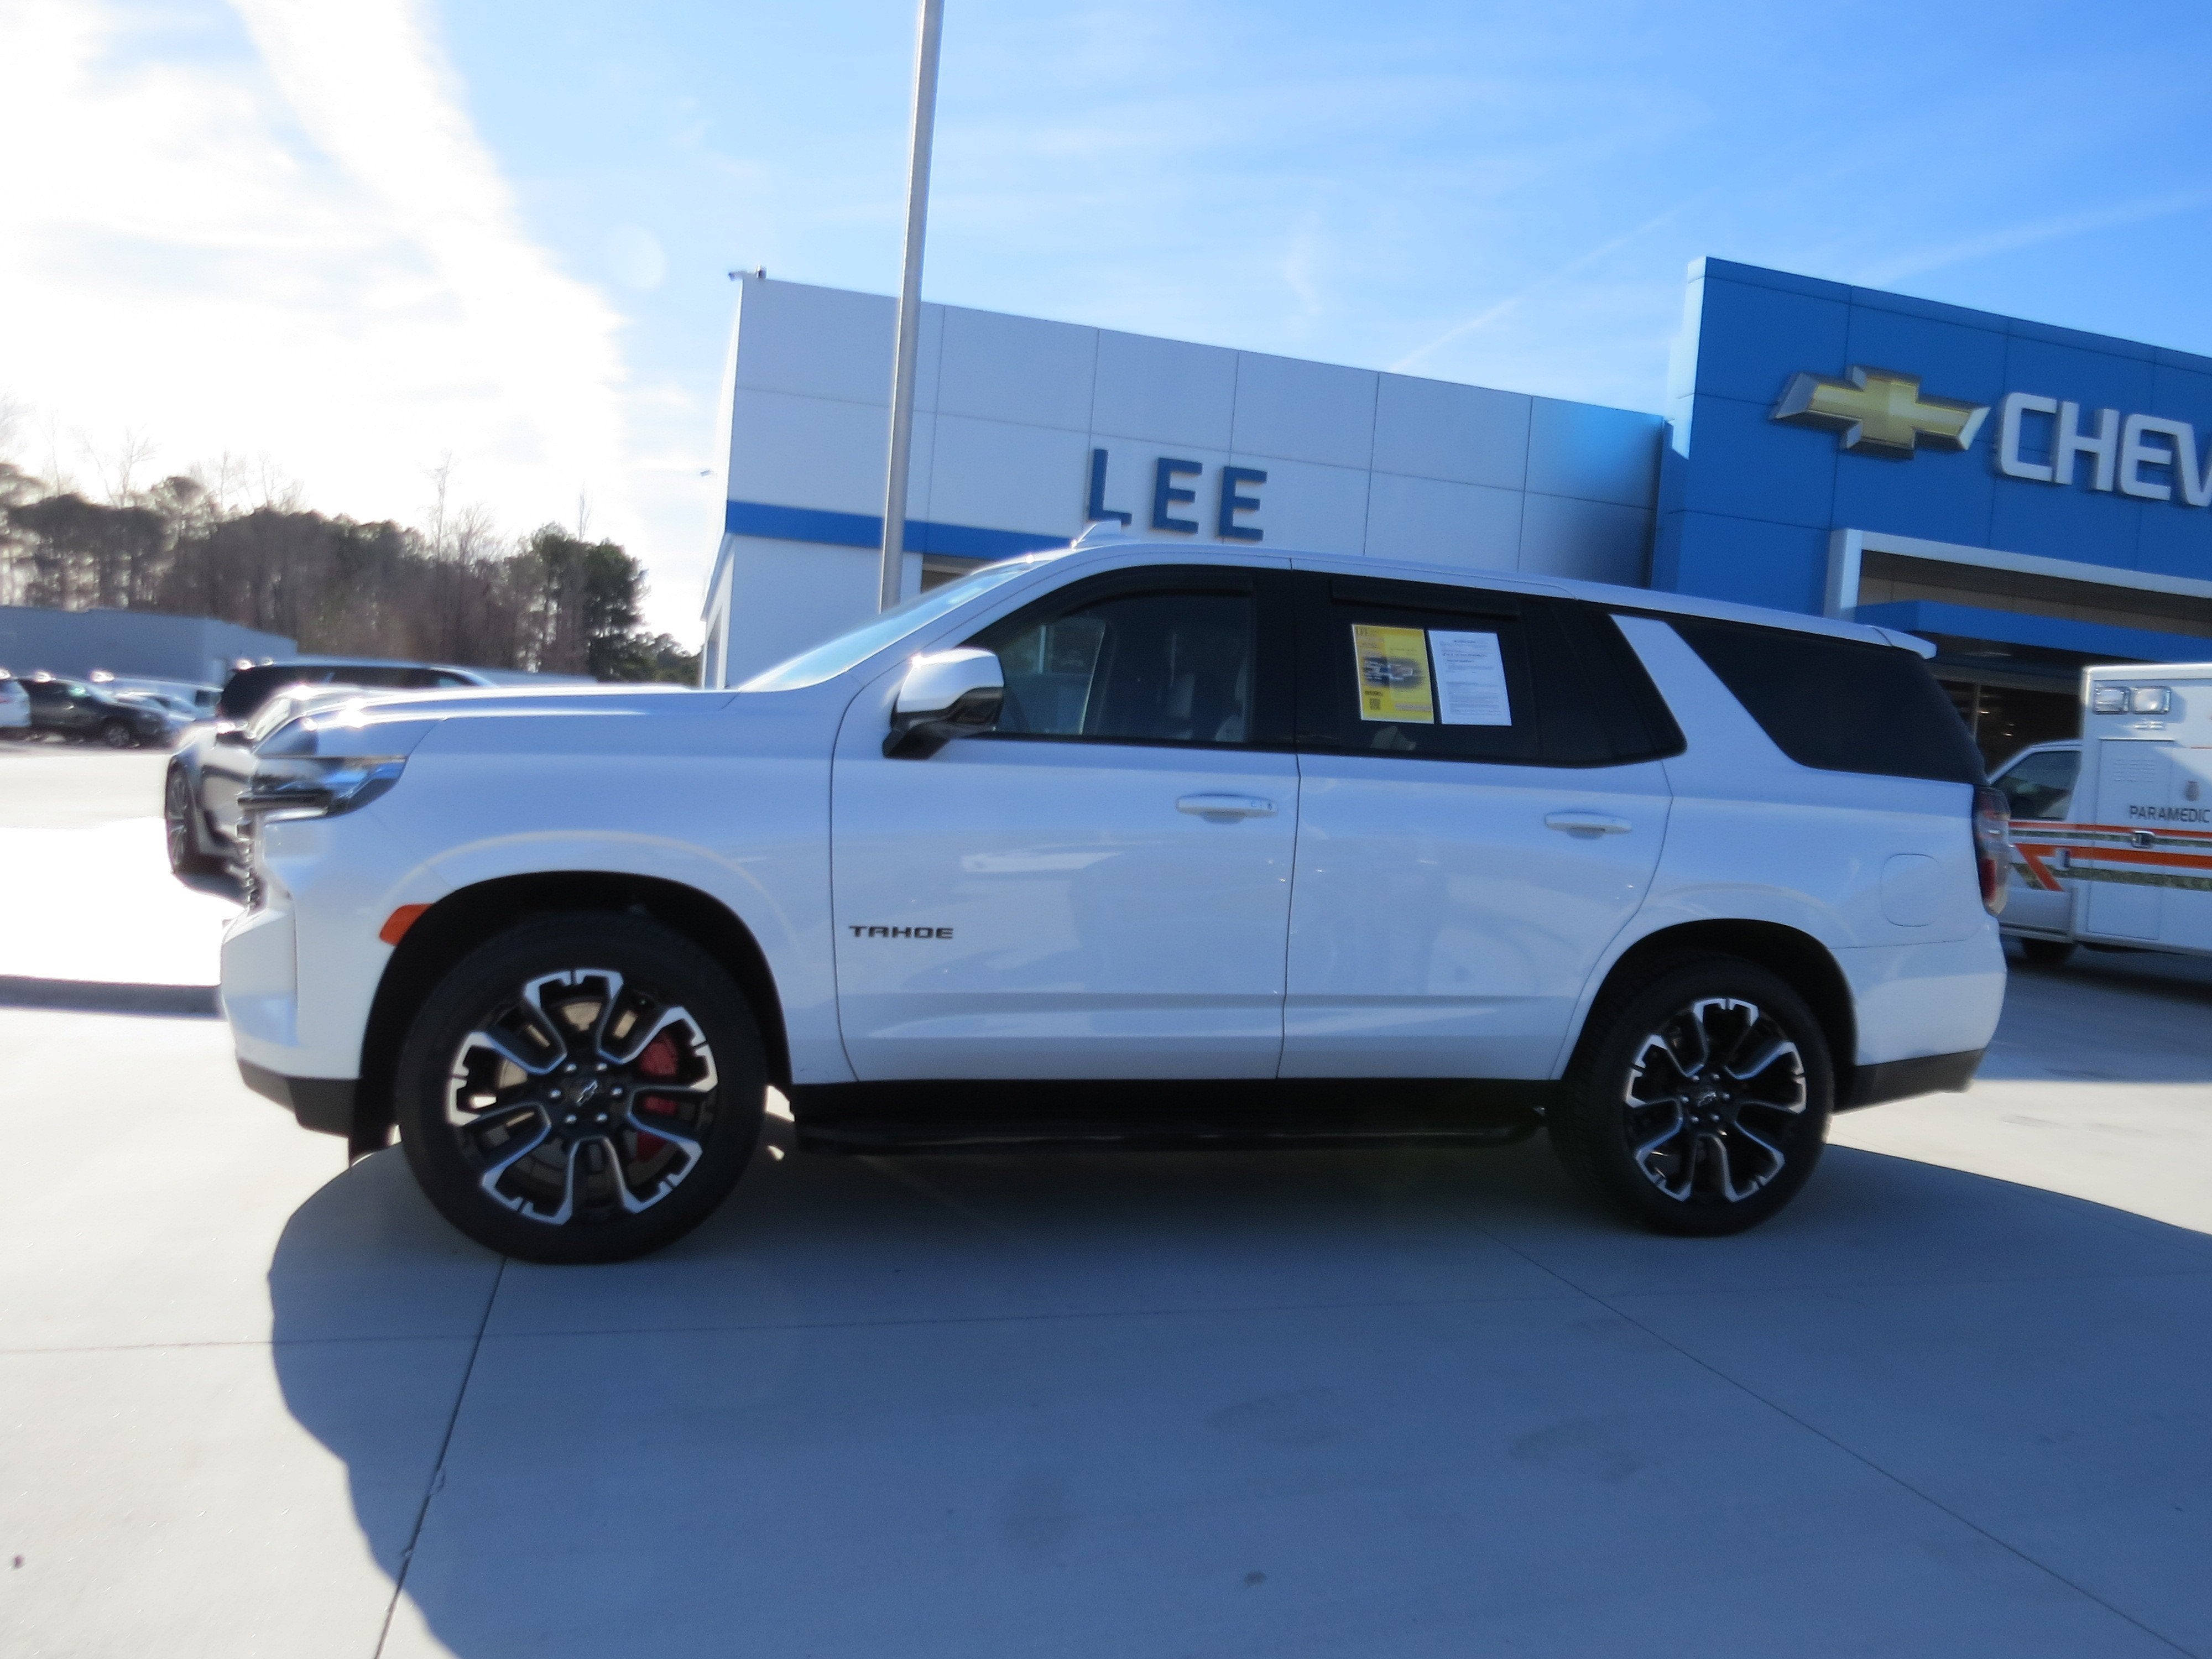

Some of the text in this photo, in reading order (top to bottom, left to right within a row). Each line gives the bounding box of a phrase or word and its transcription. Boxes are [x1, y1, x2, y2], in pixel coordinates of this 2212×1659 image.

[1088, 448, 1268, 542] LEE
[2129, 805, 2211, 823] PARAMEDIC
[849, 925, 954, 939] TAHOE
